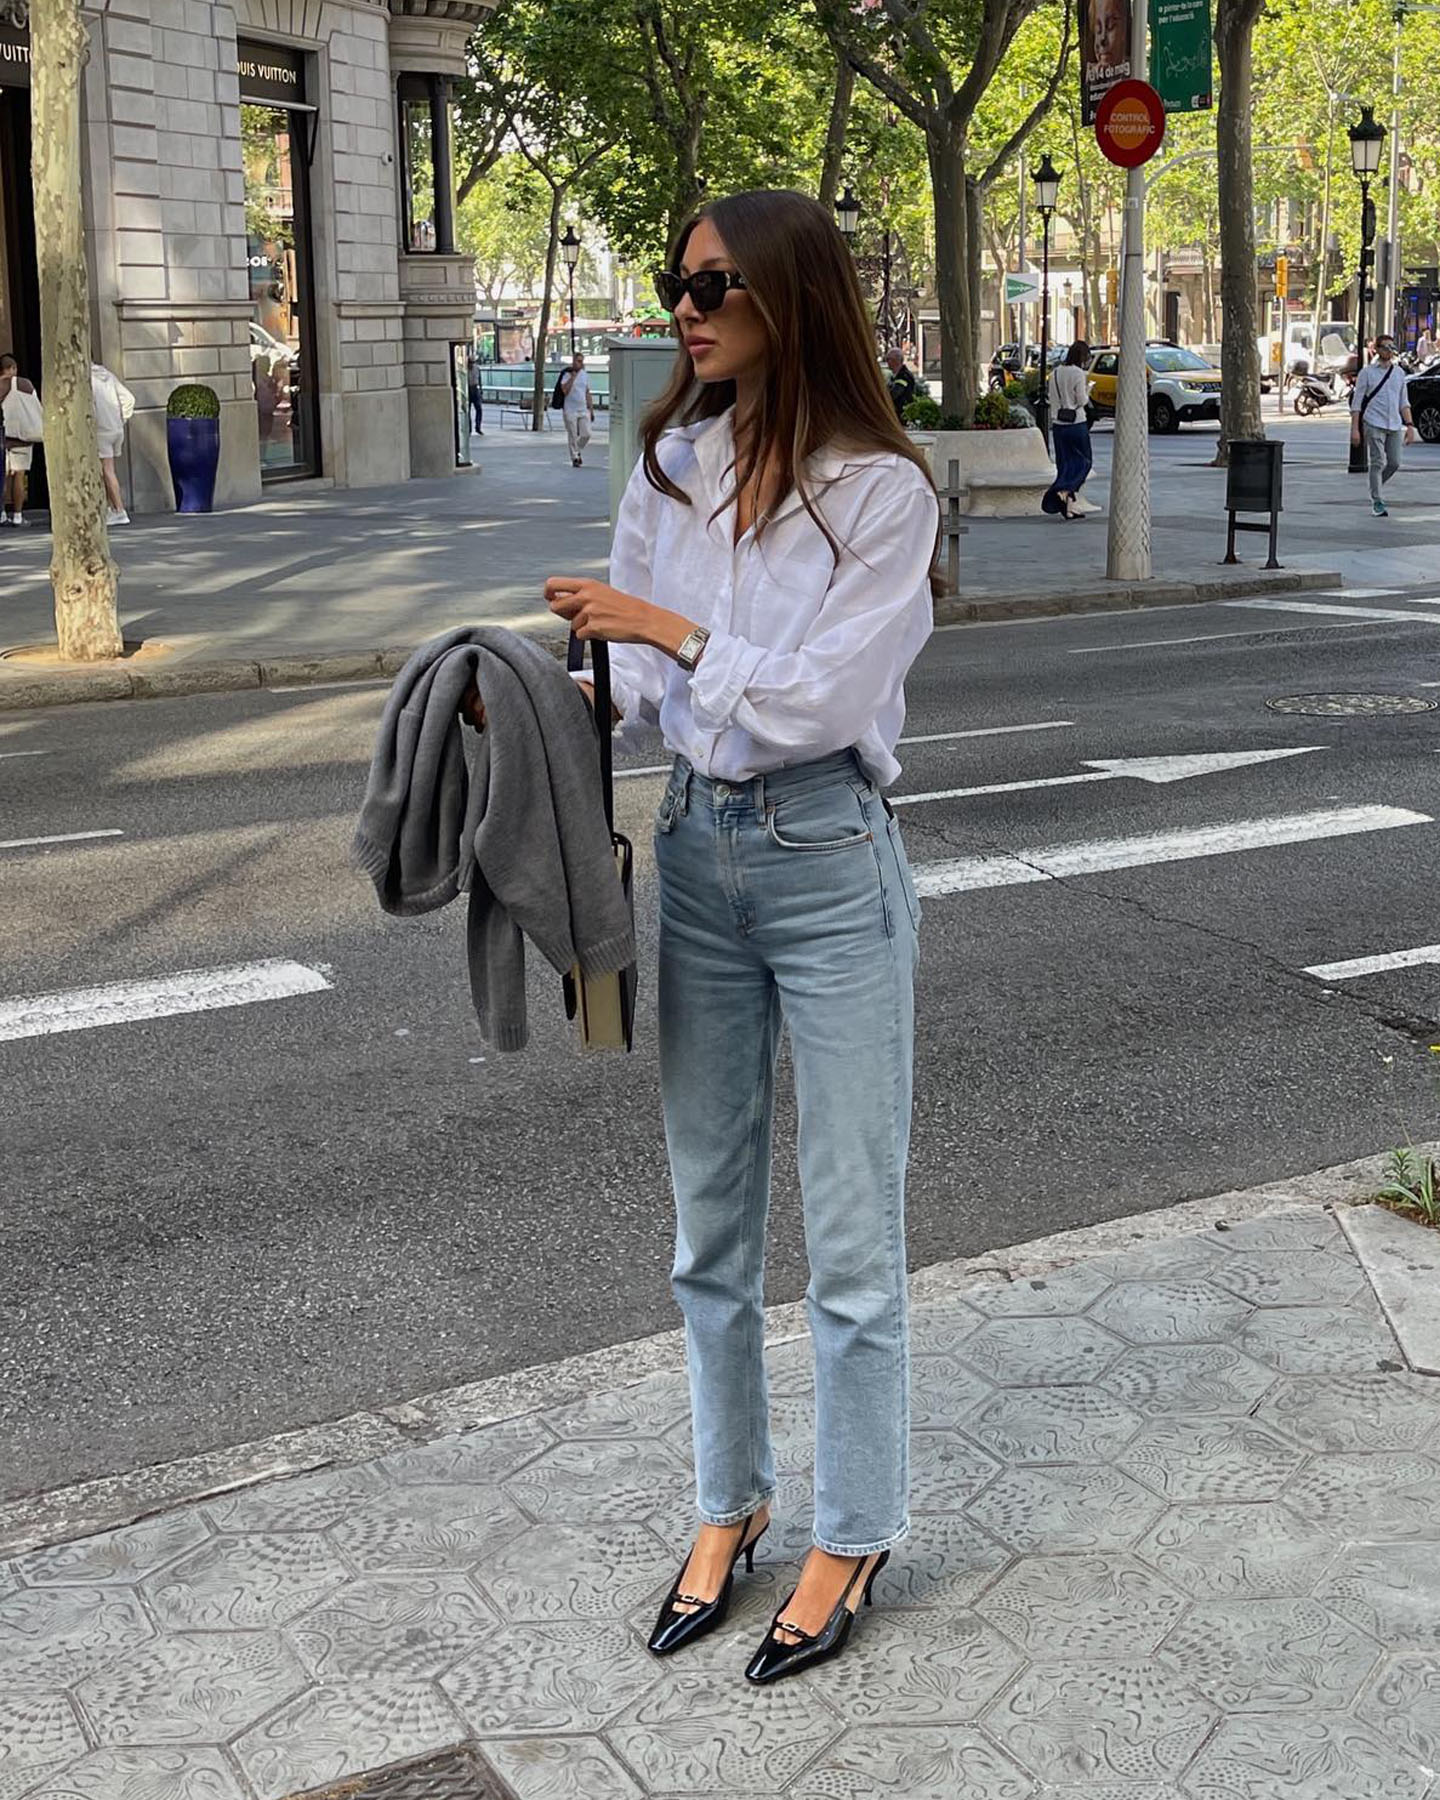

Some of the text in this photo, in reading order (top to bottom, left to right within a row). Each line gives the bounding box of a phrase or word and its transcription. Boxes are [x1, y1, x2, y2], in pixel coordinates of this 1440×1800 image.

[0, 43, 30, 63] UITT
[257, 64, 297, 84] VUITTON
[1110, 112, 1150, 124] CONTROL
